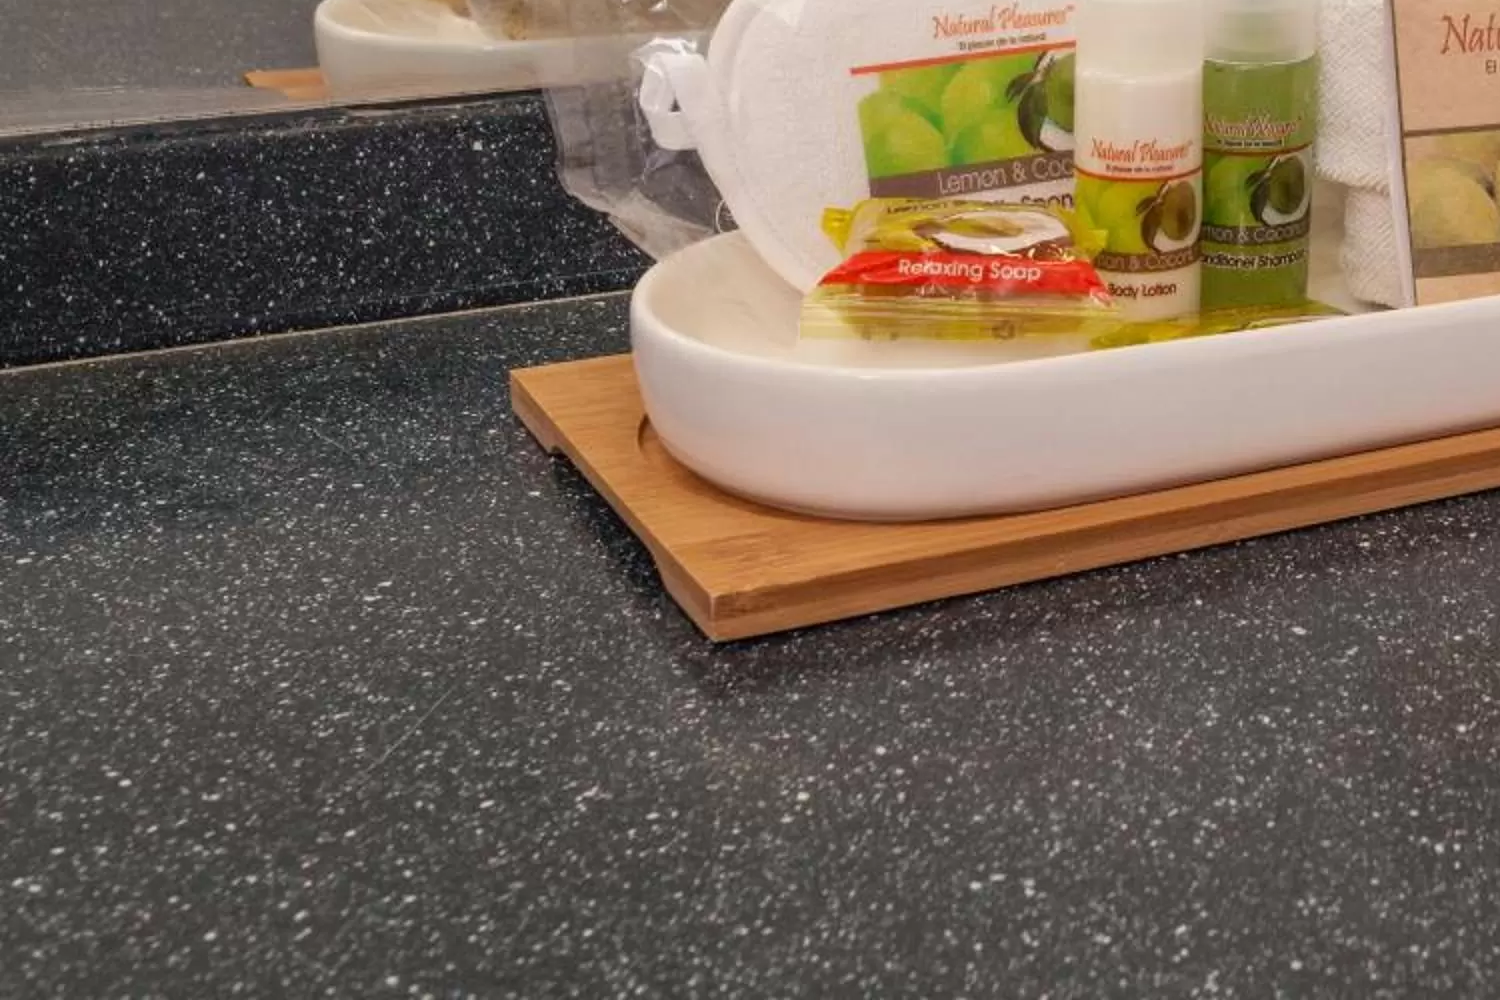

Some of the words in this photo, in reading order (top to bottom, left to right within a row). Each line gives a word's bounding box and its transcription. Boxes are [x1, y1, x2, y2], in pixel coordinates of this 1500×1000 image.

[932, 3, 996, 39] Natural
[1485, 58, 1497, 75] El
[938, 167, 1007, 194] Lemon
[1012, 162, 1027, 182] &
[898, 258, 984, 280] Relaxing
[988, 261, 1042, 281] Soap
[1142, 282, 1178, 297] Lotion
